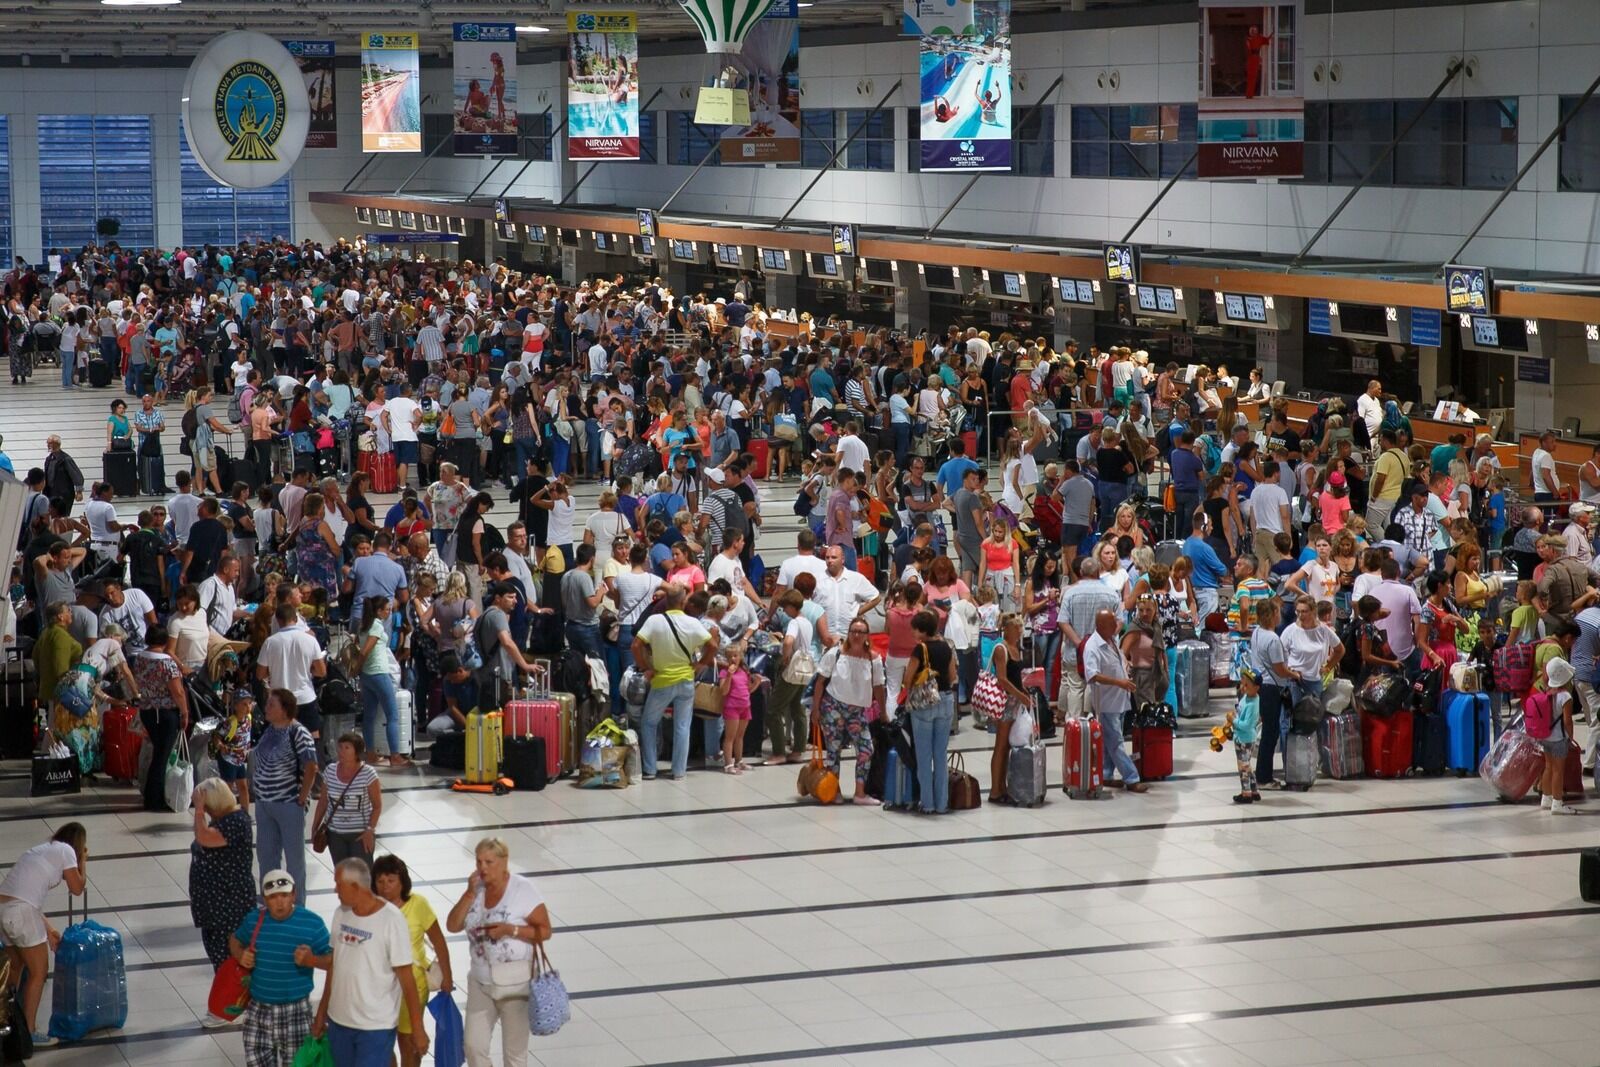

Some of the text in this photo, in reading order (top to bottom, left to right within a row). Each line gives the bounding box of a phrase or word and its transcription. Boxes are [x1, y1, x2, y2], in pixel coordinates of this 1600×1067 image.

[231, 64, 279, 90] MEYDANLARI
[218, 78, 231, 102] HAVA
[216, 105, 234, 142] DEVLET
[585, 139, 623, 147] NIRVANA
[1223, 147, 1278, 158] NIRVANA
[1329, 302, 1338, 316] 241
[1386, 307, 1397, 321] 242
[1460, 313, 1471, 328] 243
[1526, 320, 1538, 335] 244
[1586, 325, 1599, 341] 245
[46, 770, 73, 781] ARMA
